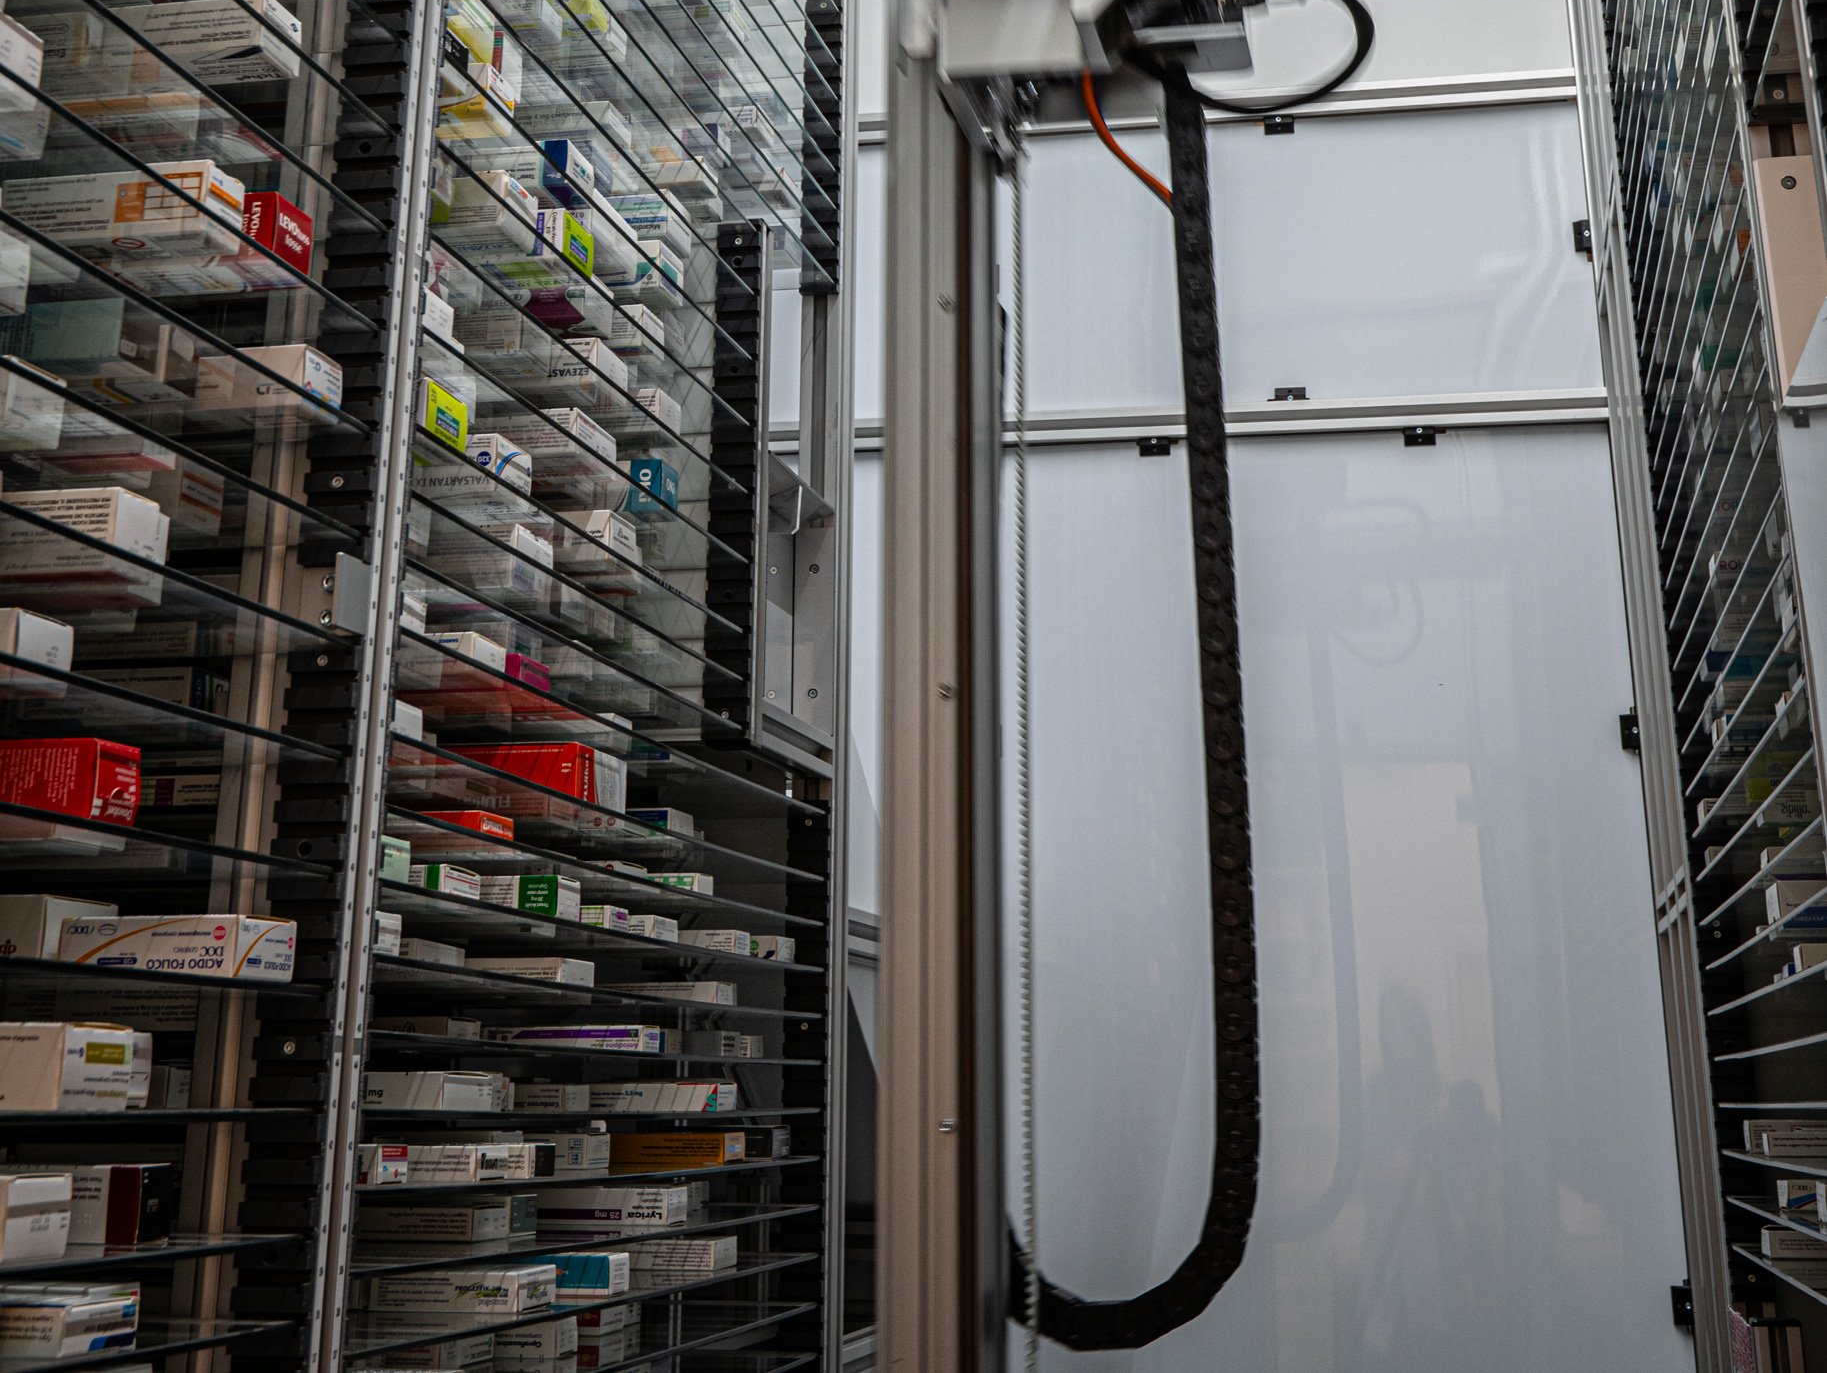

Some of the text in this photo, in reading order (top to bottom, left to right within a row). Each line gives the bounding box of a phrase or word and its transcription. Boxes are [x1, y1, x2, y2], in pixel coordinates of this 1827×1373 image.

[429, 475, 490, 488] VALSARTAN
[145, 957, 225, 971] ACIDO FOLICO
[368, 1089, 384, 1098] mg
[594, 1209, 663, 1221] Lyrica 25 mg
